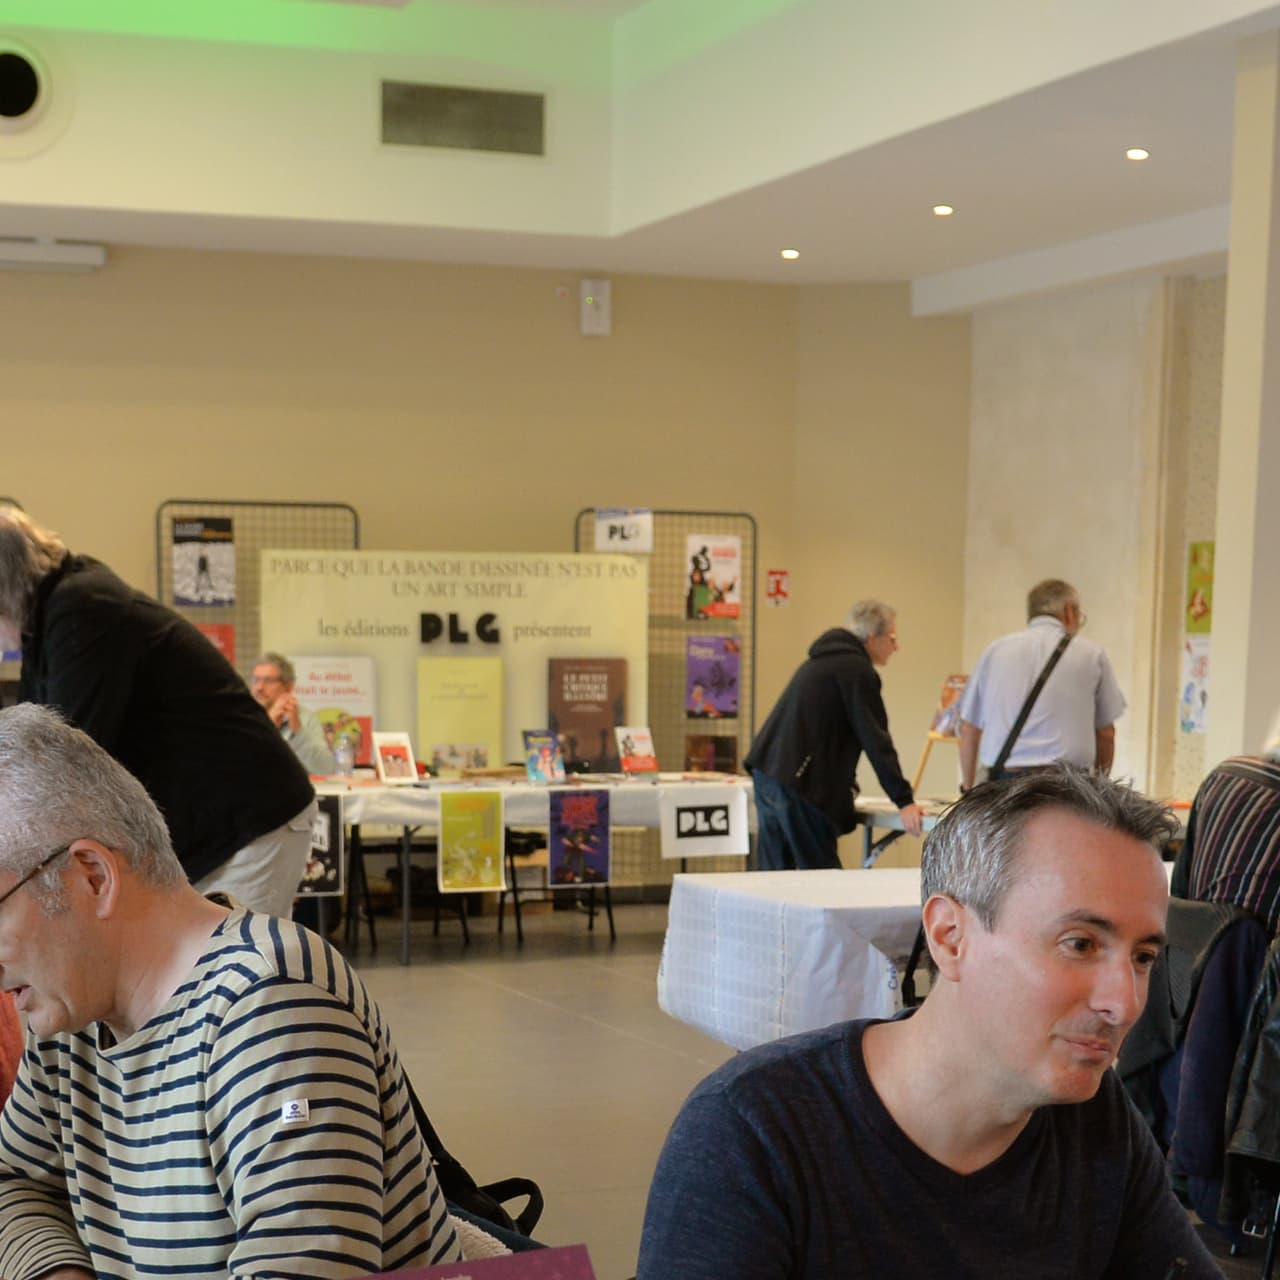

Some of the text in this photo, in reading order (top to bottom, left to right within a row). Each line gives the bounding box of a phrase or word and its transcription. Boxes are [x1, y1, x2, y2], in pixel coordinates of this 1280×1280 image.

[271, 558, 327, 576] PARCE
[332, 558, 371, 580] QUE
[378, 559, 401, 576] LA
[405, 558, 465, 577] BANDE
[470, 557, 554, 577] DESSINÉE
[609, 561, 639, 578] PAS
[392, 582, 528, 599] UN ART SIMPLE
[319, 612, 592, 645] les éditions PLG présentent
[678, 809, 728, 833] PLG
